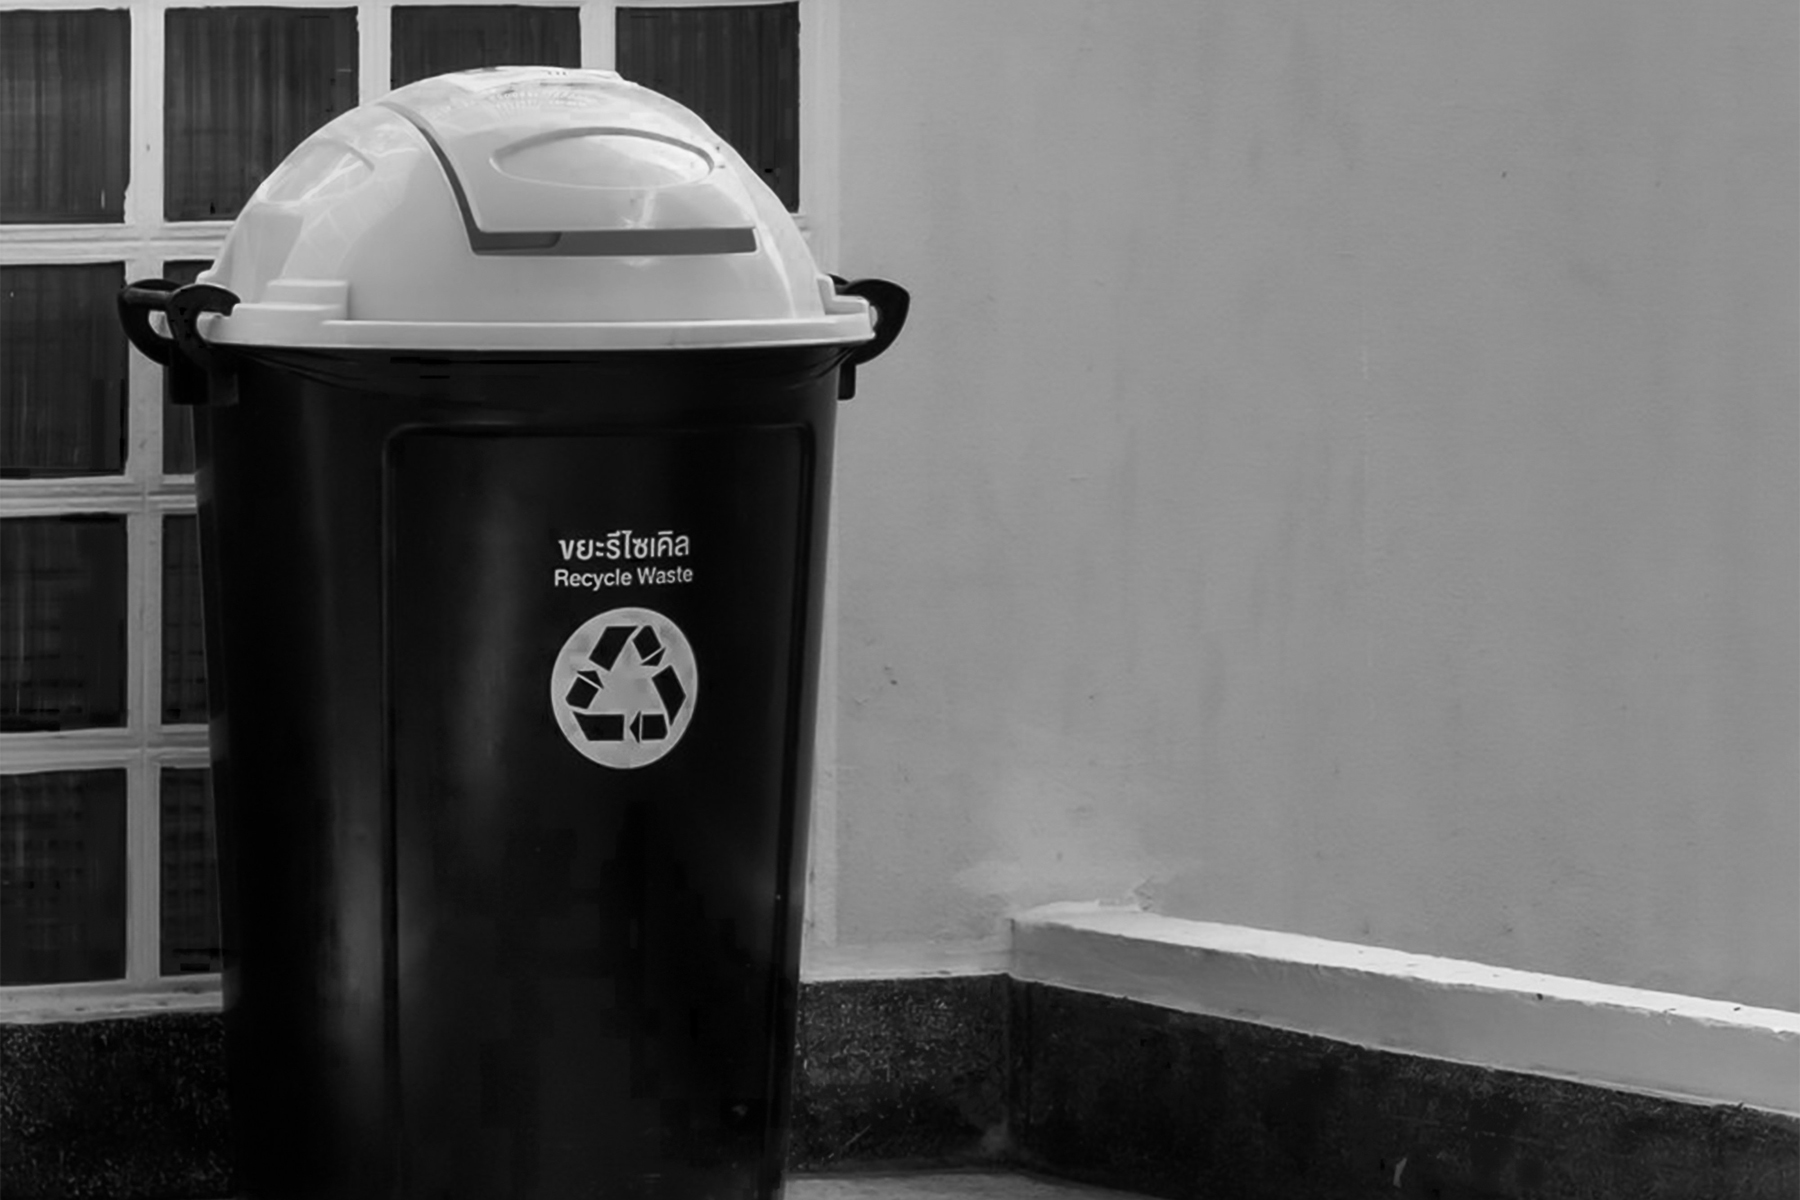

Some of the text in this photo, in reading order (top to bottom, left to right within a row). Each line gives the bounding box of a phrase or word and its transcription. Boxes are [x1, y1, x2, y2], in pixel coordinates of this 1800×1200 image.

[558, 530, 690, 561] ขยะรีไซเคิล
[554, 566, 693, 592] Recycle Waste
